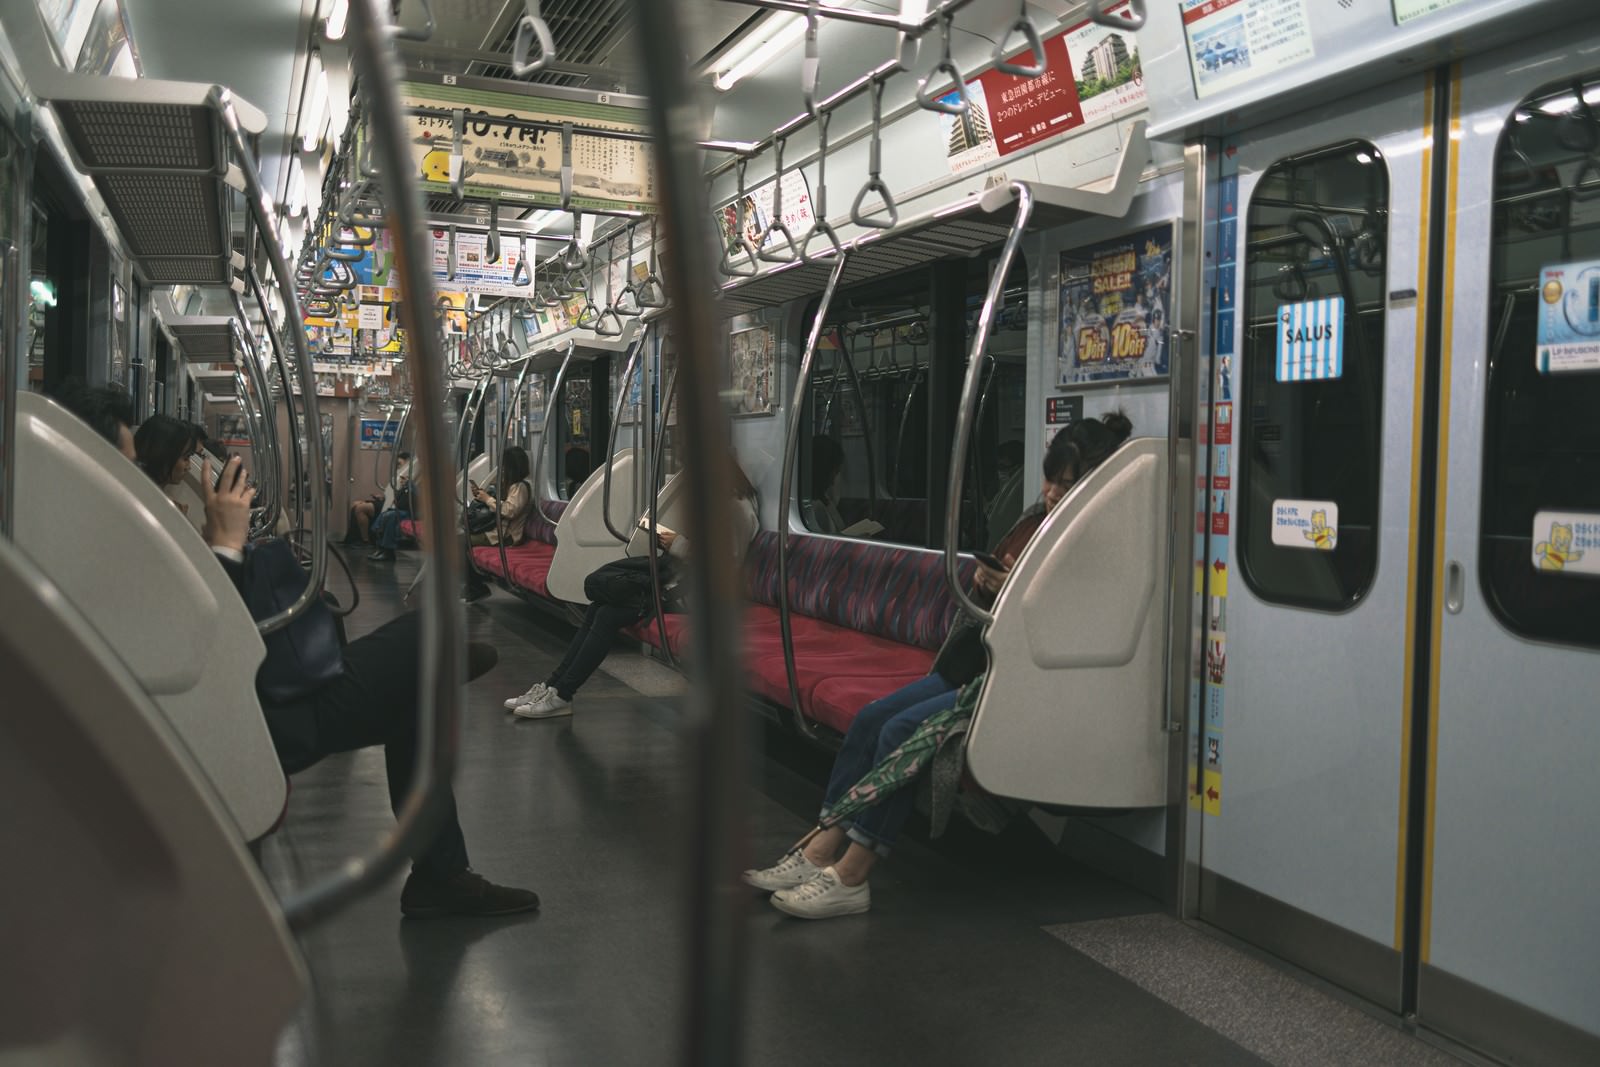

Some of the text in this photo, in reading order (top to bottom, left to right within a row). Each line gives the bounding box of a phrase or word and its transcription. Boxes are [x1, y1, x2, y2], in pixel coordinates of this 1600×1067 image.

[446, 75, 454, 84] 5
[600, 94, 607, 103] 6
[1286, 324, 1332, 344] SALUS
